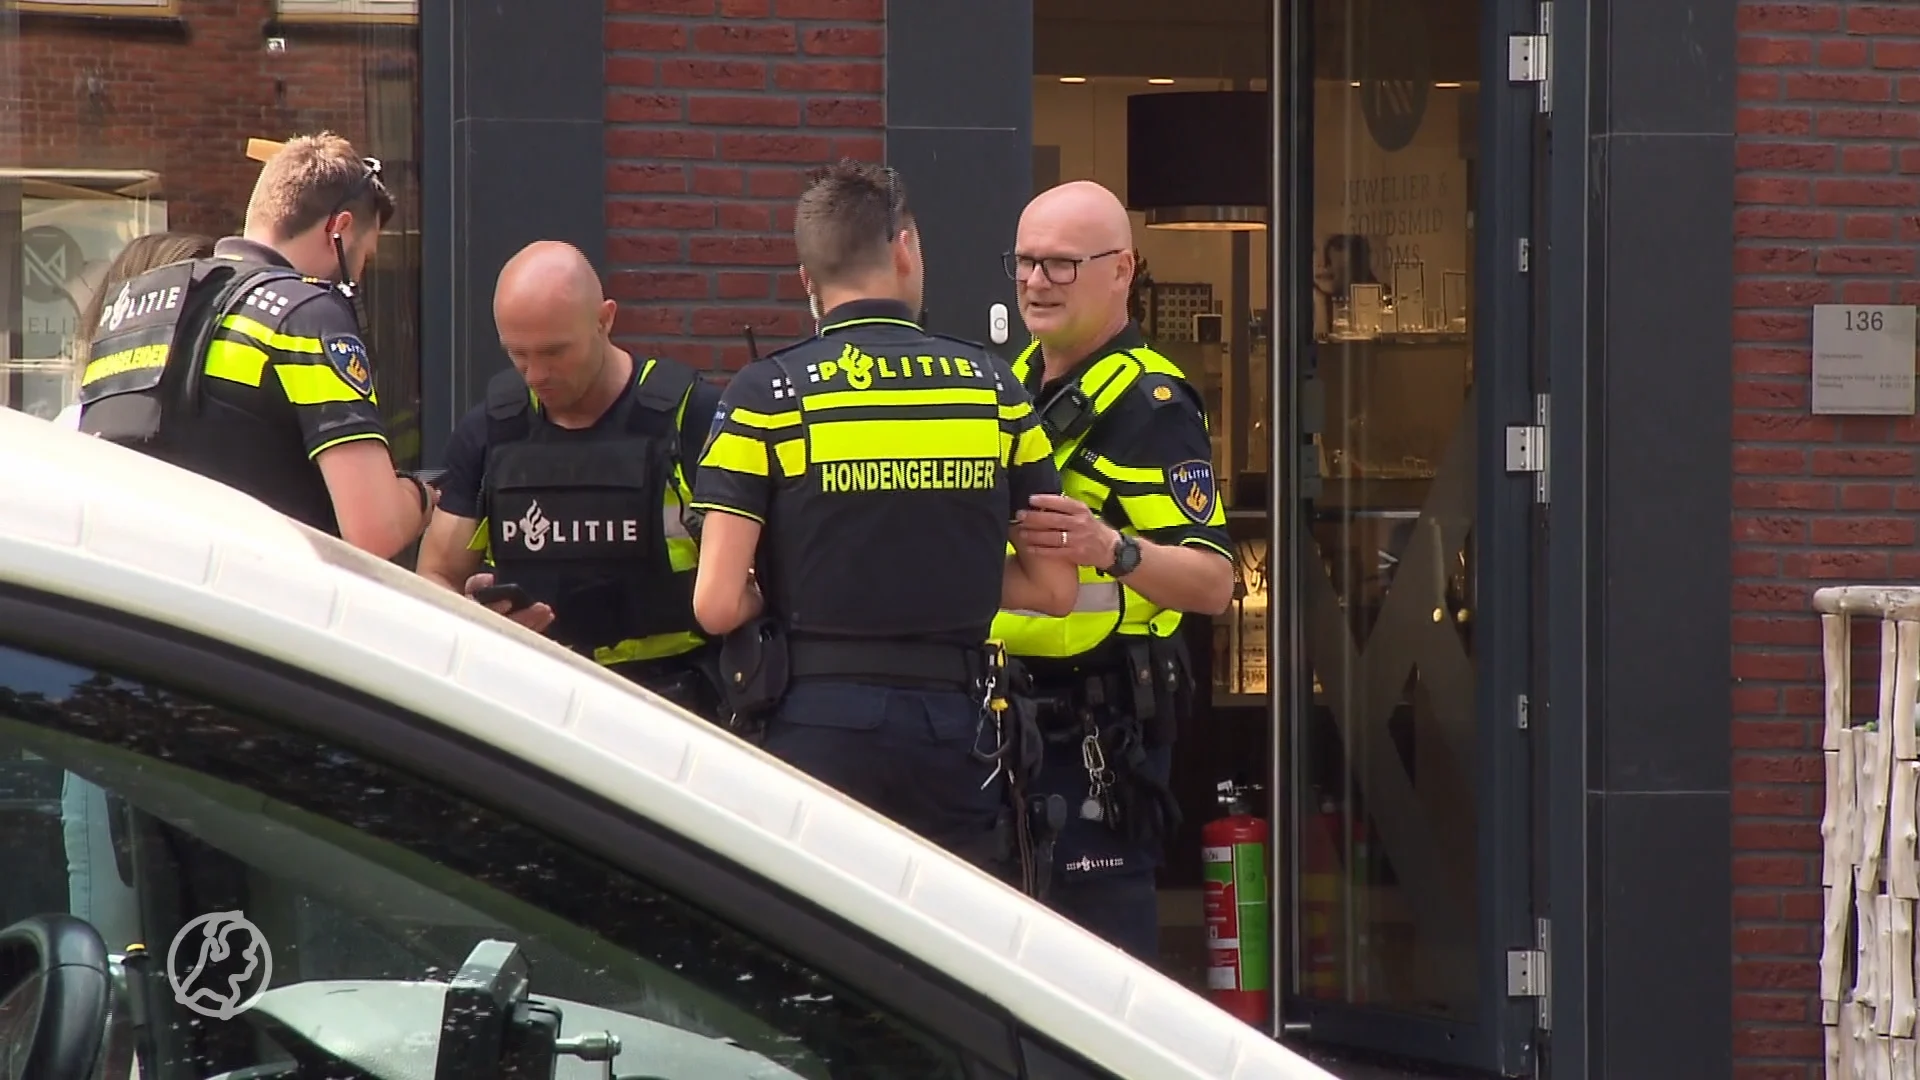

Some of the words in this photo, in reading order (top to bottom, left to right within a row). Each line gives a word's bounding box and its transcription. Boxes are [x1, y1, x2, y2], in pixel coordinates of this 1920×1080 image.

[1347, 206, 1444, 238] GOUDSMID
[99, 281, 181, 331] POLITIE
[1844, 310, 1884, 332] 136
[818, 343, 974, 390] POLITIE
[821, 459, 996, 493] HONDENGELEIDER
[1172, 466, 1210, 483] POLITIE
[502, 500, 638, 552] POLITIE
